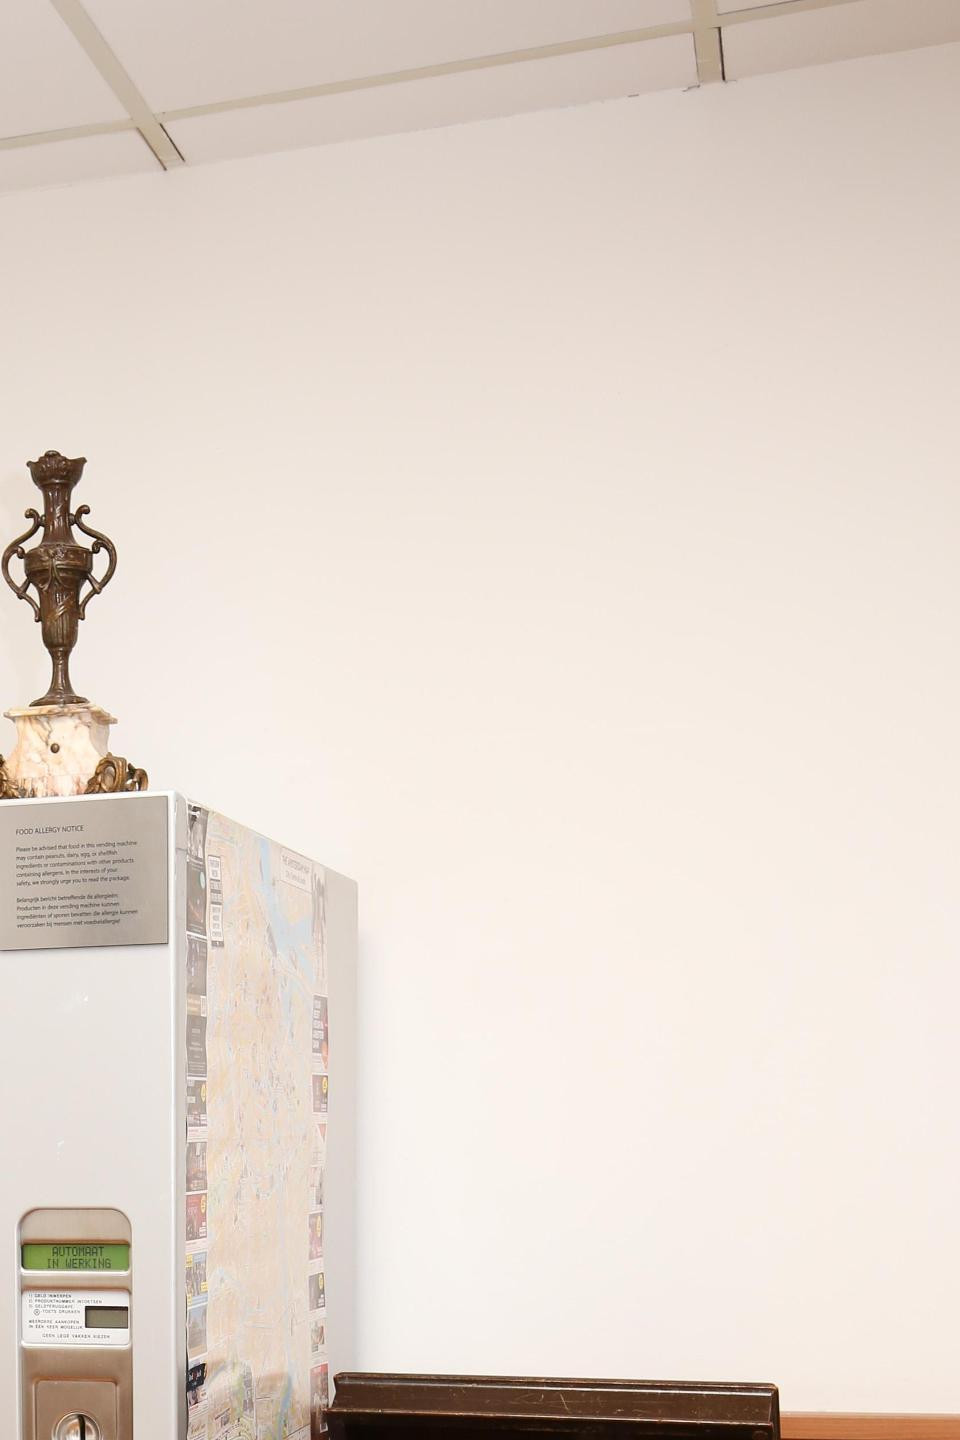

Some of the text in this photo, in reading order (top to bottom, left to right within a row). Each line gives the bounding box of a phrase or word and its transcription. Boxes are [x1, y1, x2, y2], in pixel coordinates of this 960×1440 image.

[52, 1247, 104, 1256] AUTOMAAT
[47, 1259, 111, 1269] IN WERKING
